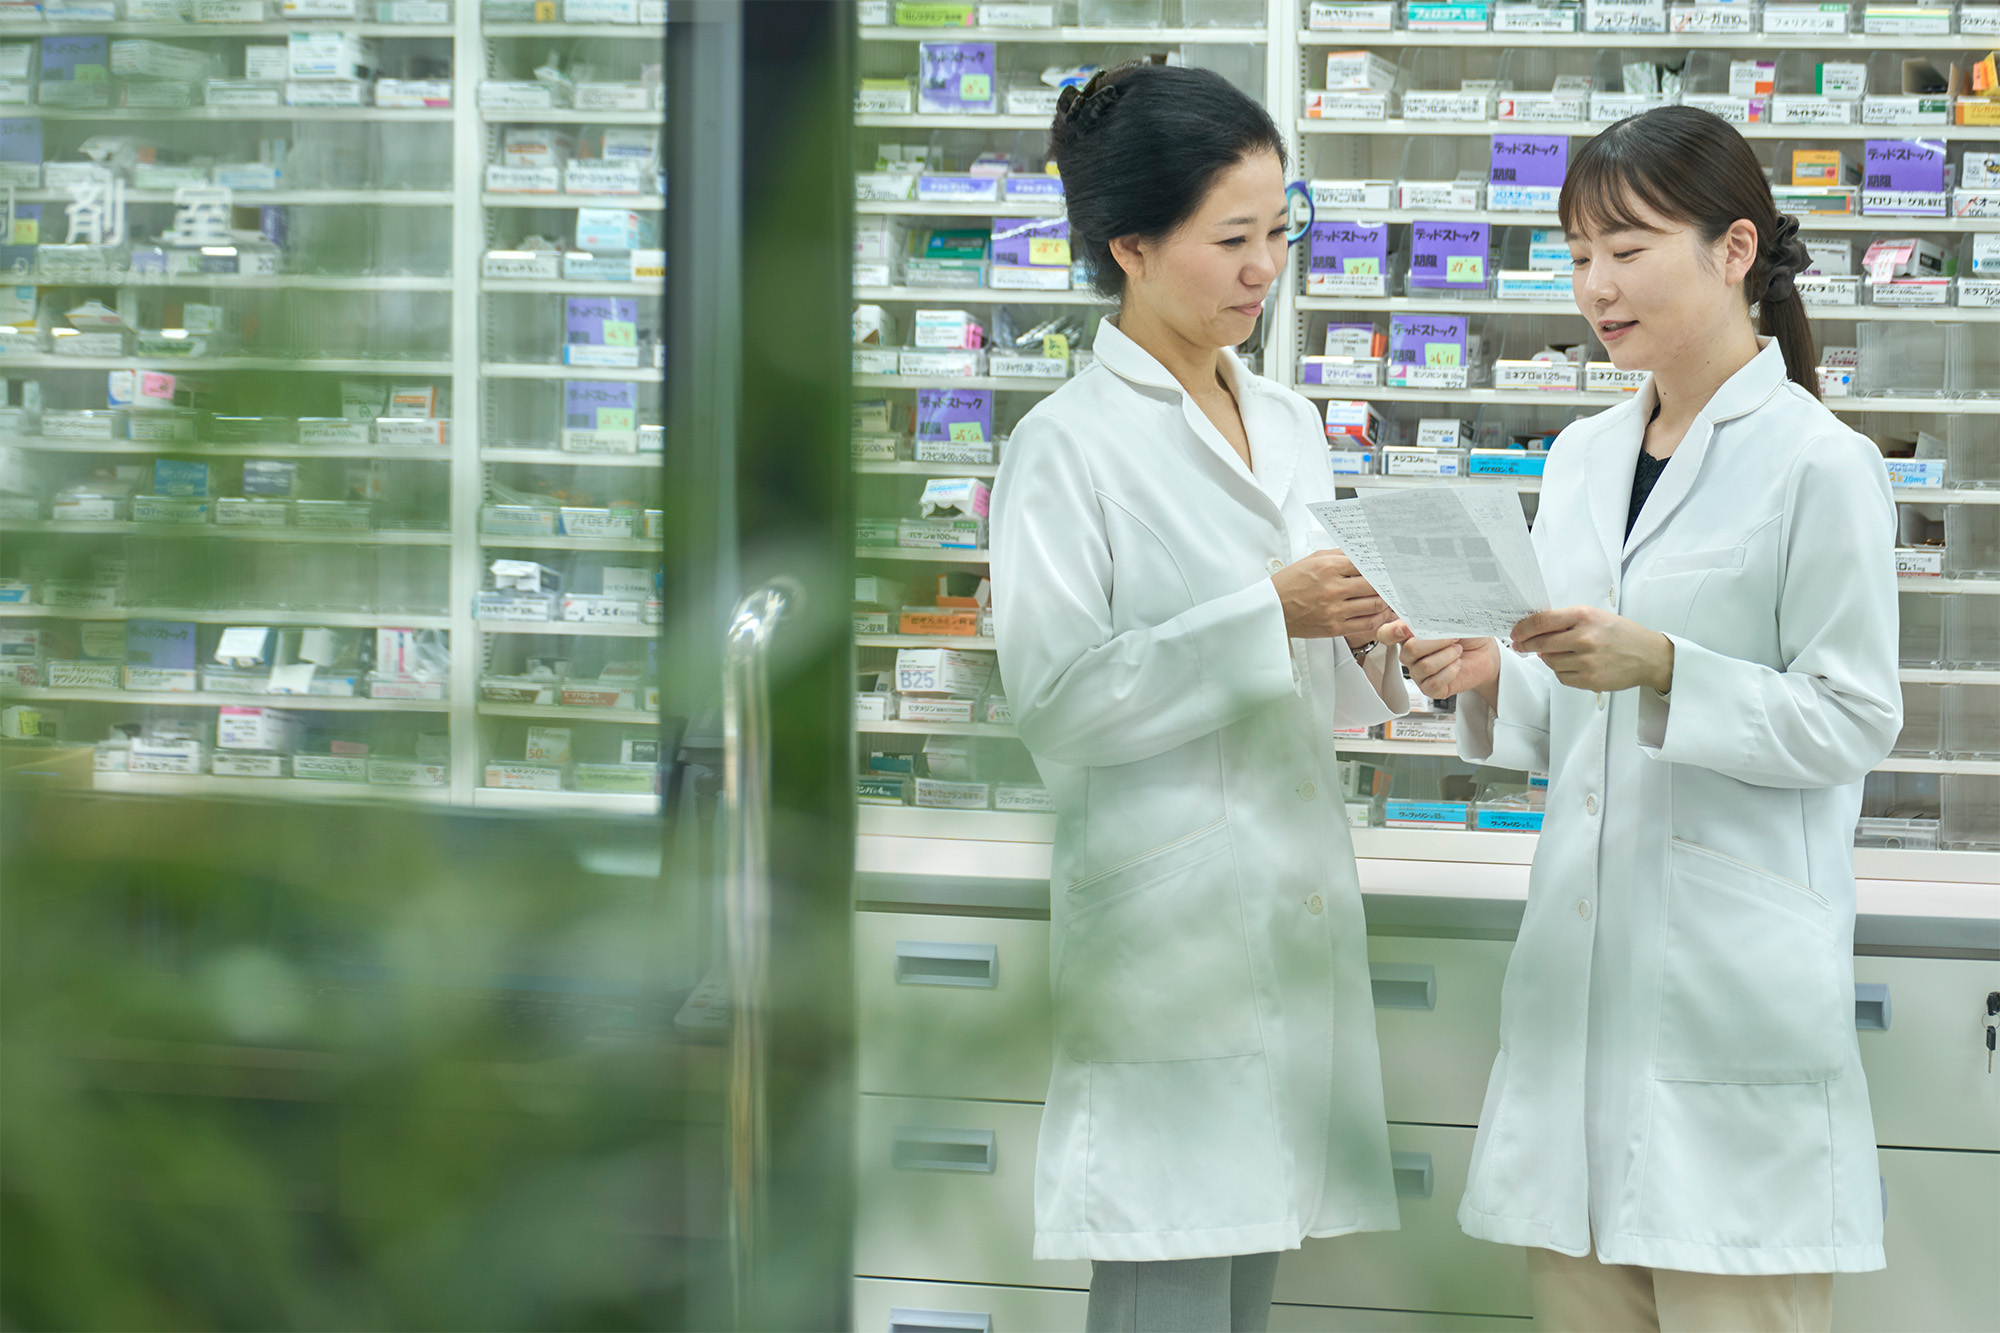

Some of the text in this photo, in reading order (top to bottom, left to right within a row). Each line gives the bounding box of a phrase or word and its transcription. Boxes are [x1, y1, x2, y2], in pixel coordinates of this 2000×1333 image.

[1775, 17, 1834, 28] フォリアミン錠
[1494, 142, 1559, 155] デッドストック
[1867, 148, 1934, 160] デッドストック
[1493, 168, 1516, 181] 期限
[1867, 174, 1891, 187] 期限
[1313, 230, 1379, 242] デッドストック
[1415, 228, 1480, 242] デッドストック
[1312, 256, 1337, 269] 期限
[1414, 254, 1438, 268] 期限
[1393, 323, 1458, 337] デッドストック
[1393, 349, 1416, 362] 期限
[1590, 371, 1647, 382] ミネブロ錠2.5
[920, 396, 983, 409] デッドストック
[900, 670, 935, 688] B25
